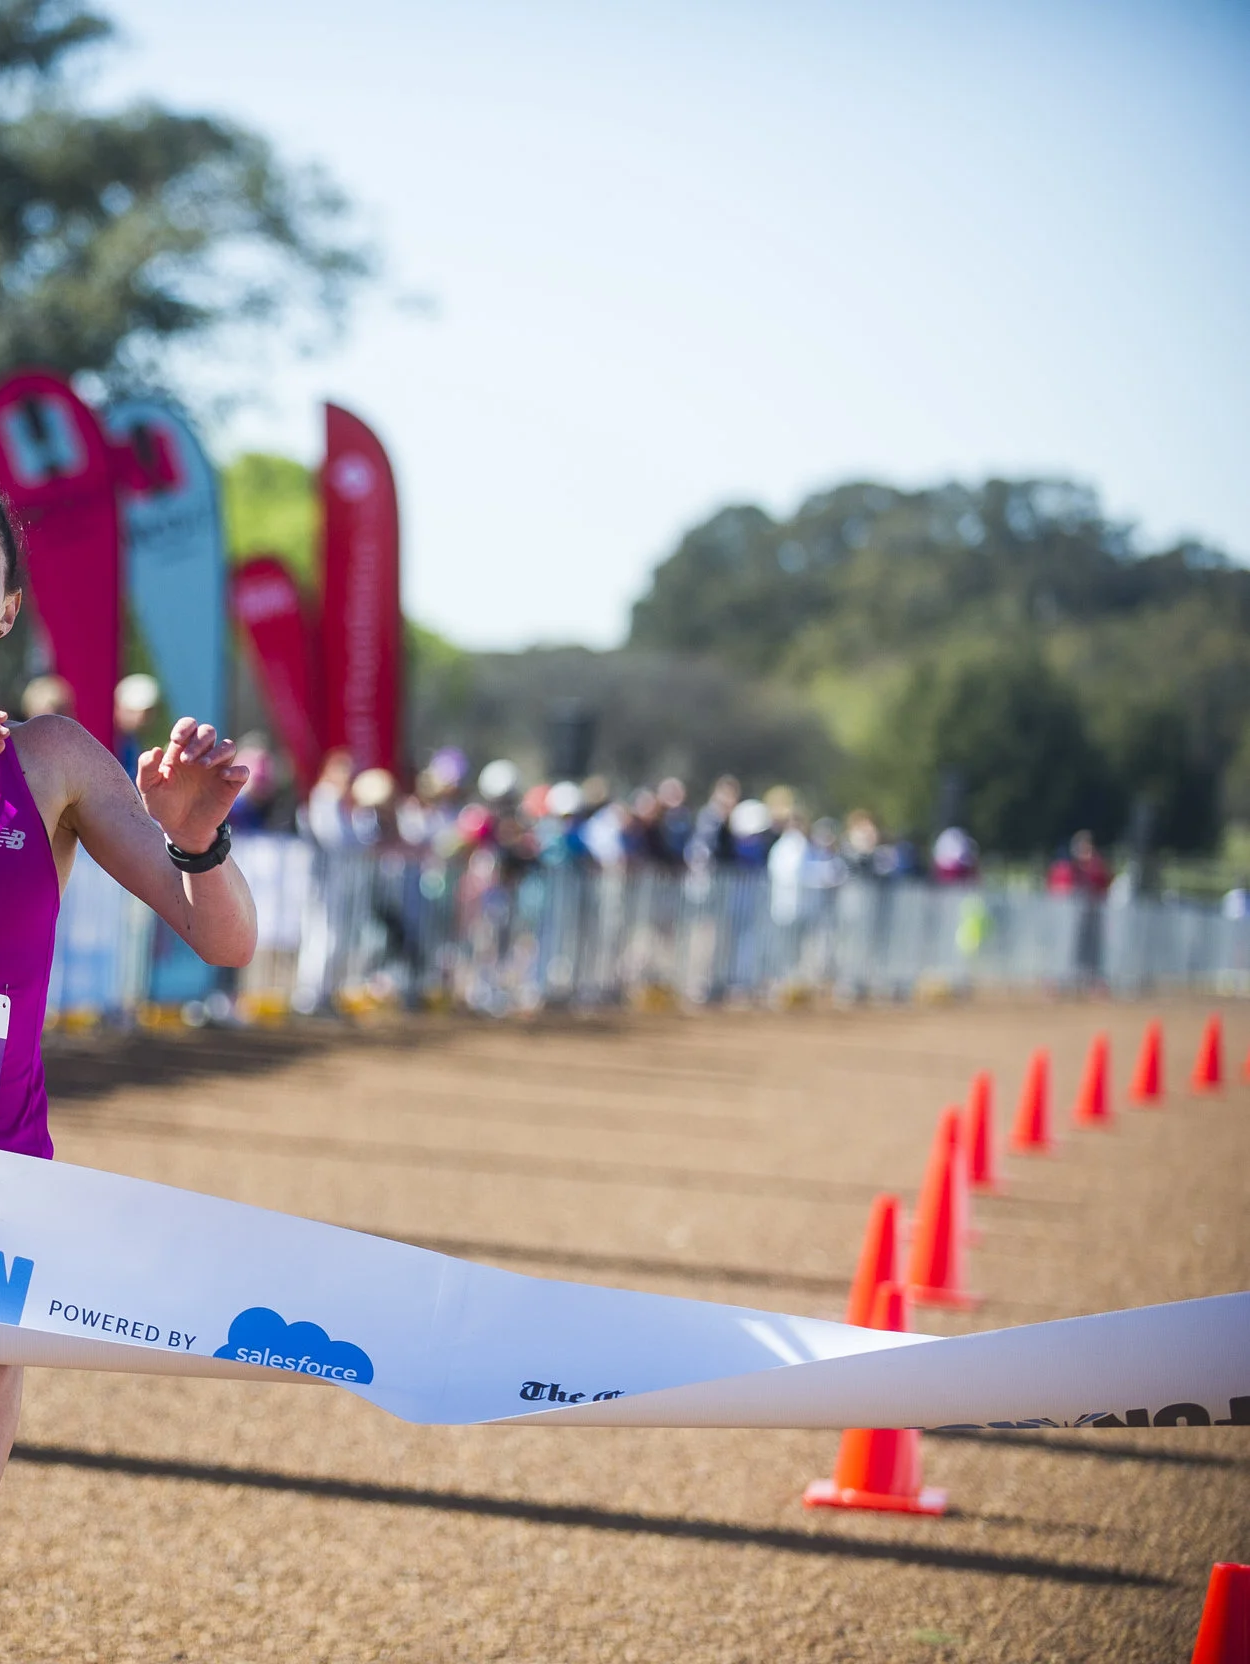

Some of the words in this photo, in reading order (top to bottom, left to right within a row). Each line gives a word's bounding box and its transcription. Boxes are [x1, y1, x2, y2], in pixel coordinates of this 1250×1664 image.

[49, 1299, 160, 1342] POWERED
[167, 1330, 197, 1351] BY
[235, 1347, 358, 1381] salesforce
[519, 1381, 587, 1404] The
